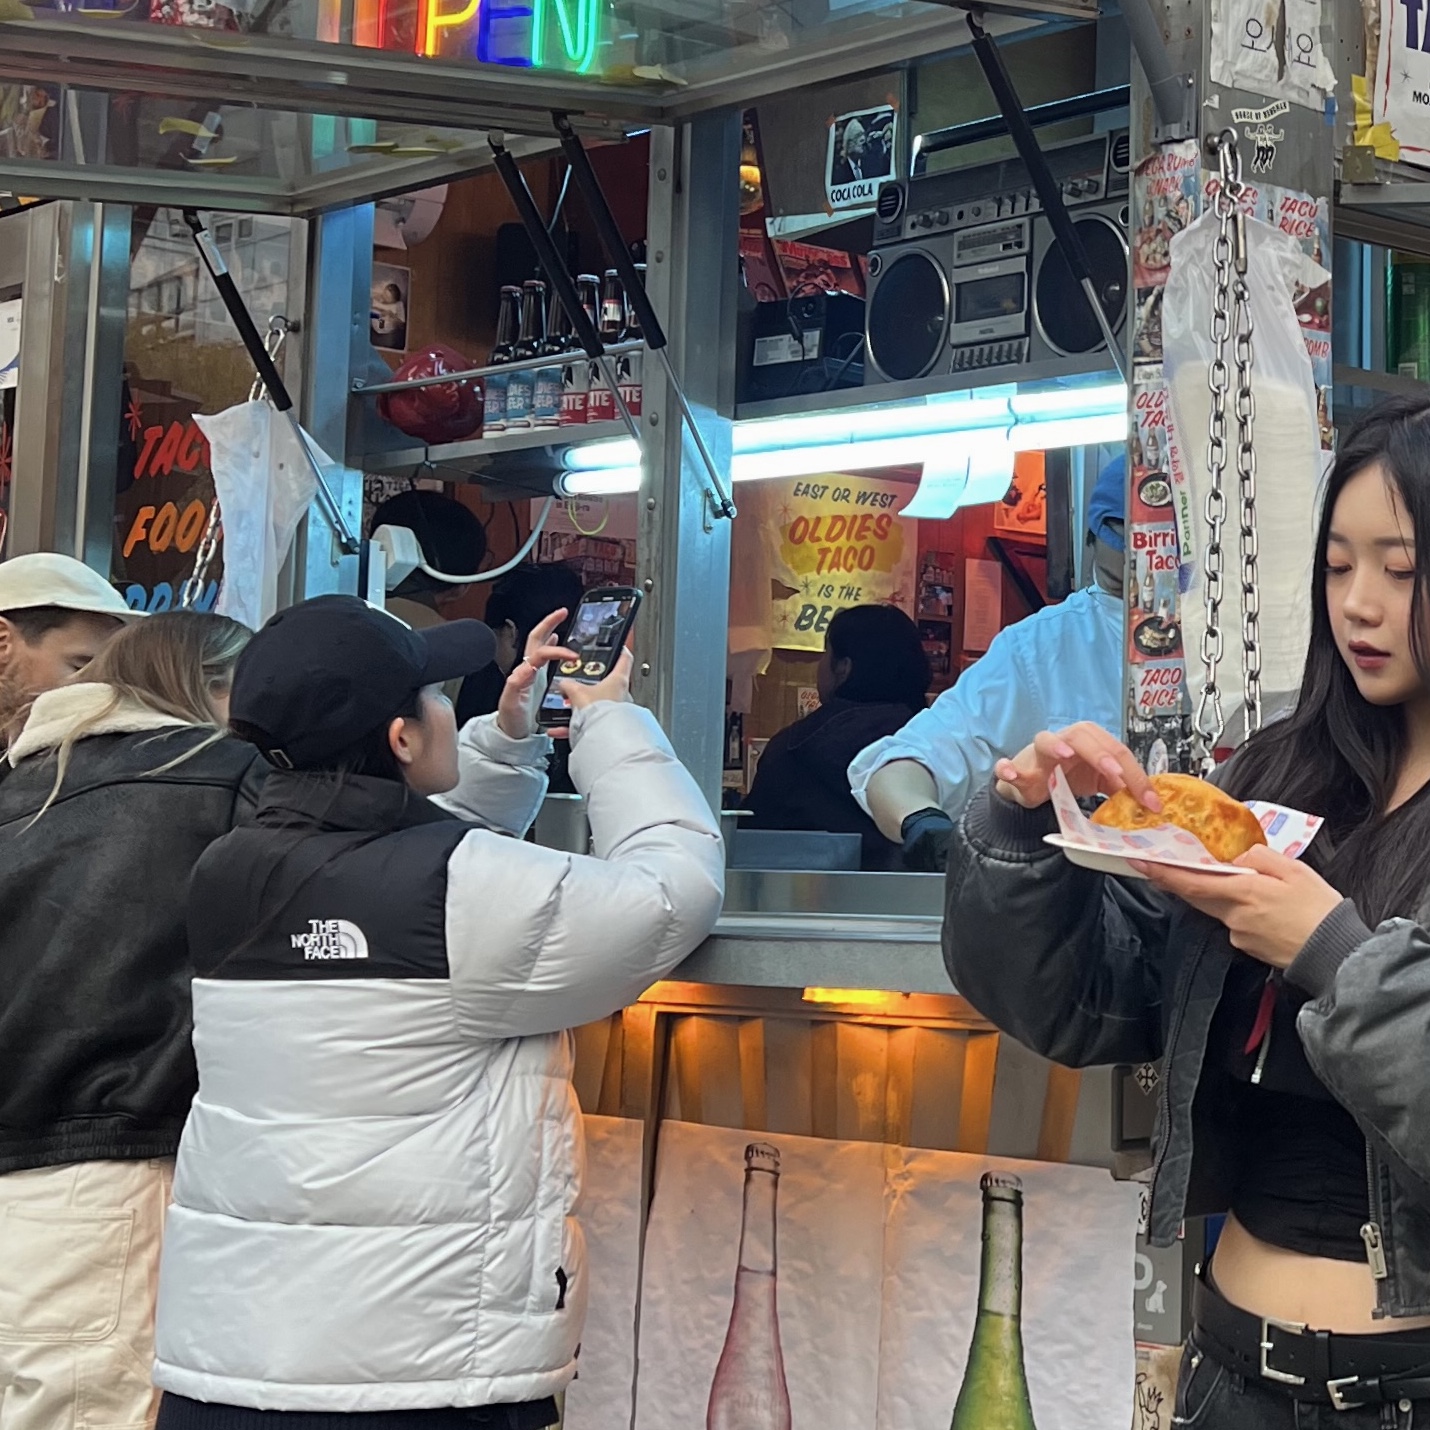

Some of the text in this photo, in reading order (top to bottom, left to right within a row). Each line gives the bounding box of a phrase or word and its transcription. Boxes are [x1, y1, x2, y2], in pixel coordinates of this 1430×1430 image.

[831, 183, 873, 203] COCA COLA
[1278, 216, 1316, 238] RICE
[793, 482, 898, 509] EAST OR WEST
[788, 513, 893, 545] OLDIES
[815, 545, 876, 576] TACO
[817, 583, 862, 601] IS THE
[1141, 667, 1182, 687] TACO
[1139, 687, 1179, 708] RICE
[308, 919, 339, 933] THE
[290, 933, 340, 949] NORTH
[304, 945, 341, 960] FACE
